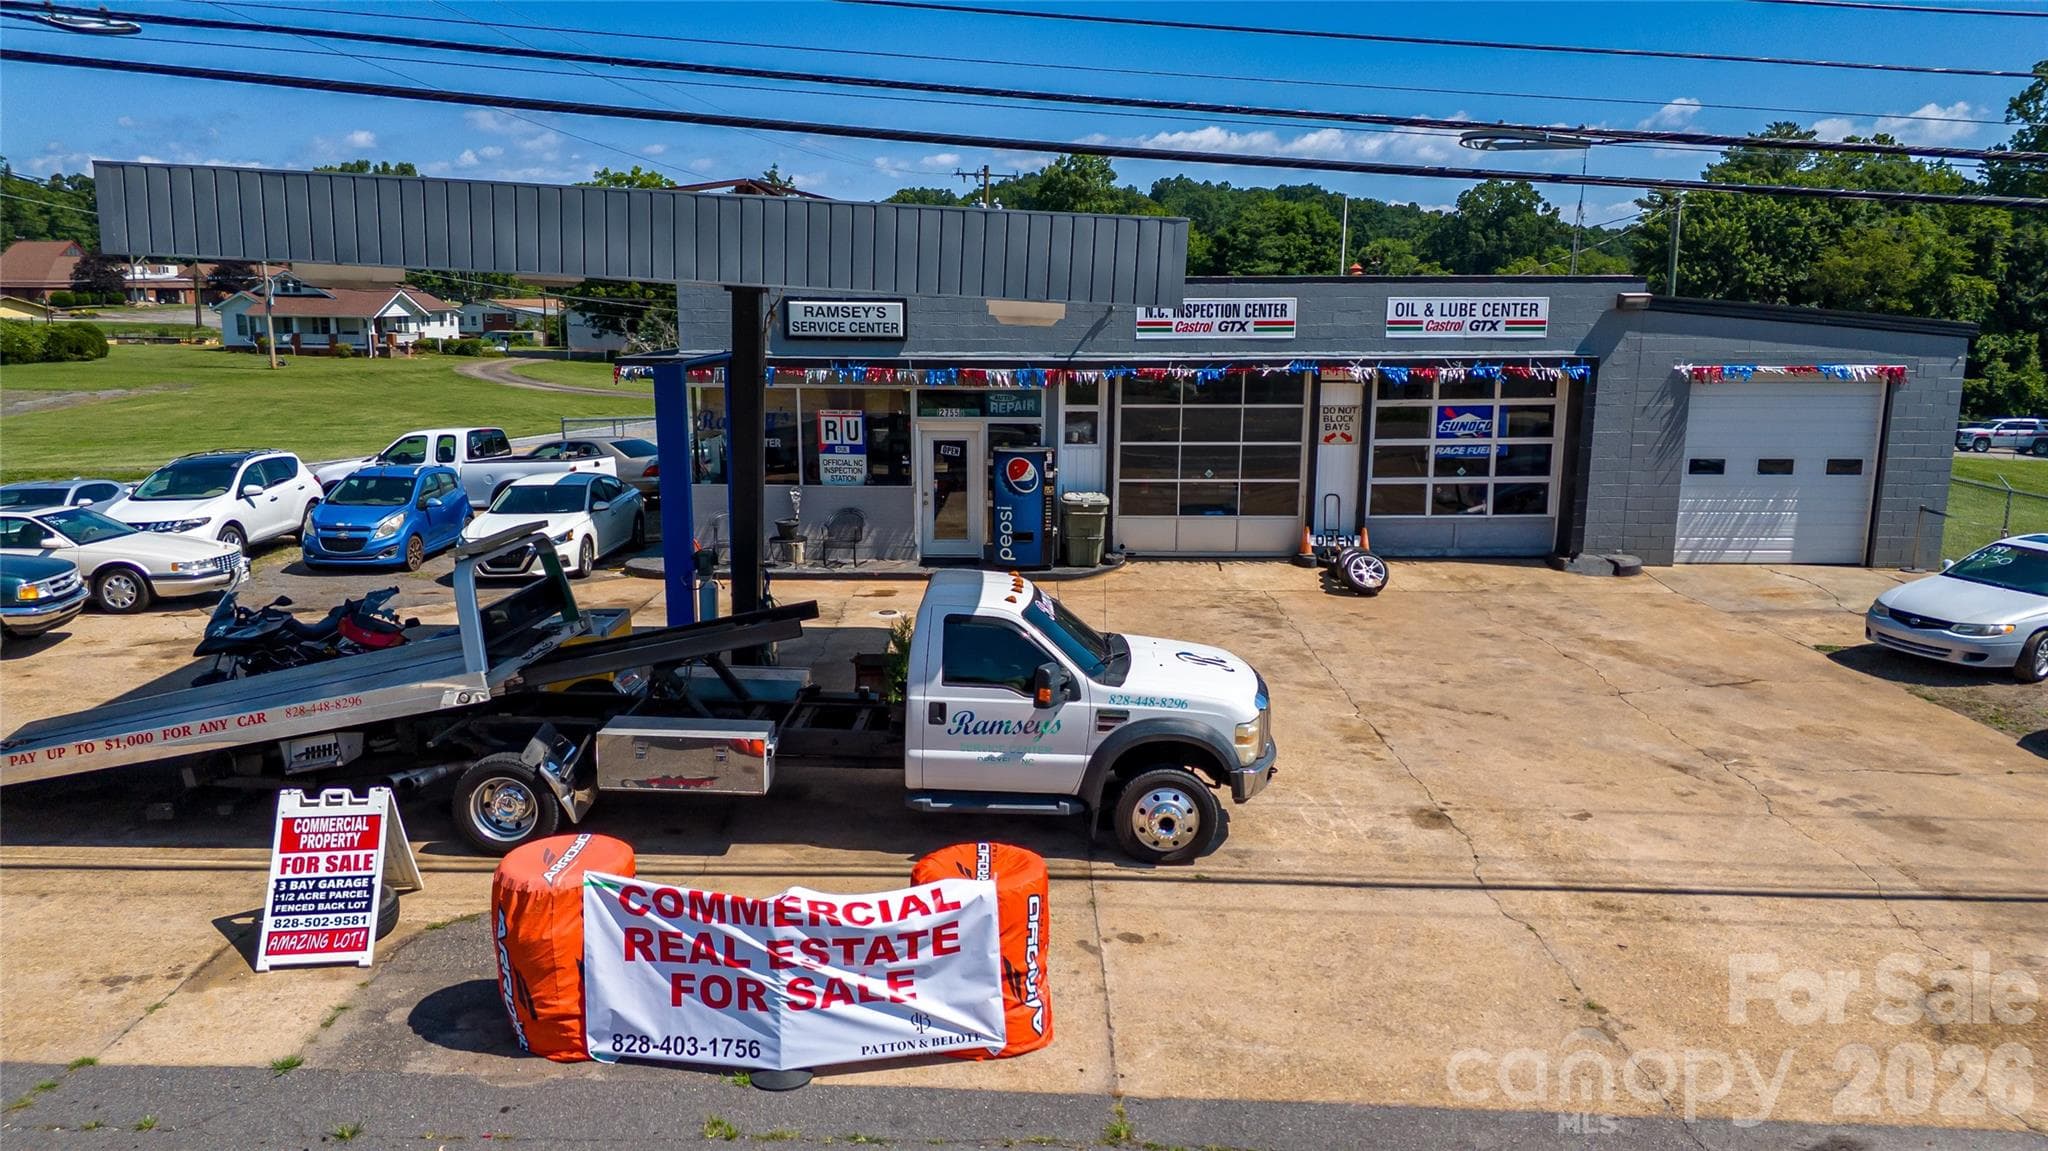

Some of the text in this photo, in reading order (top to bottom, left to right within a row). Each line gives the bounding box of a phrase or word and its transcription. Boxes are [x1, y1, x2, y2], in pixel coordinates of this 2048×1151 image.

[804, 306, 887, 318] RAMSEY'S
[1173, 303, 1241, 318] INSPECTION
[1244, 303, 1288, 318] CENTER
[1395, 302, 1539, 317] OIL & LUBE CENTER
[792, 321, 899, 334] SERVICE CENTER
[1175, 321, 1250, 333] Castrol GTX
[1425, 320, 1501, 332] Castrol GTX
[990, 399, 1036, 413] REPAIR
[1323, 406, 1358, 415] DO NOT
[1323, 415, 1354, 423] BLOCK
[1440, 420, 1493, 432] SUNOCO
[825, 420, 859, 441] R U
[1325, 423, 1351, 431] BAYS
[942, 446, 960, 456] OPEN
[1435, 446, 1465, 455] RACE
[823, 459, 864, 467] OFFICIAL NC
[824, 467, 863, 475] INSPECTION
[997, 506, 1017, 561] pepsi
[1315, 535, 1355, 546] OPEN
[284, 696, 363, 718] 828-448-8296
[1108, 693, 1189, 710] 828-448-8296
[9, 711, 267, 767] PAY UP TO $1,000 FOR ANY CAR
[293, 816, 370, 834] COMMERCIAL
[299, 832, 361, 849] PROPERTY
[280, 853, 374, 875] FOR SALE
[279, 878, 369, 890] 3 BAY GARAGE
[297, 892, 326, 901] ACRE
[329, 890, 370, 899] PARCEL
[275, 901, 368, 913] FENCED BACK LOT
[619, 885, 961, 928] COMMERCIAL
[273, 915, 368, 929] 828-502-9581
[268, 931, 364, 951] AMAZING LOT!
[624, 920, 961, 970] REAL ESTATE
[671, 969, 917, 1012] FOR SALE
[611, 1033, 762, 1059] 828-403-1756
[861, 1039, 916, 1056] PATTON
[919, 1038, 928, 1048] &
